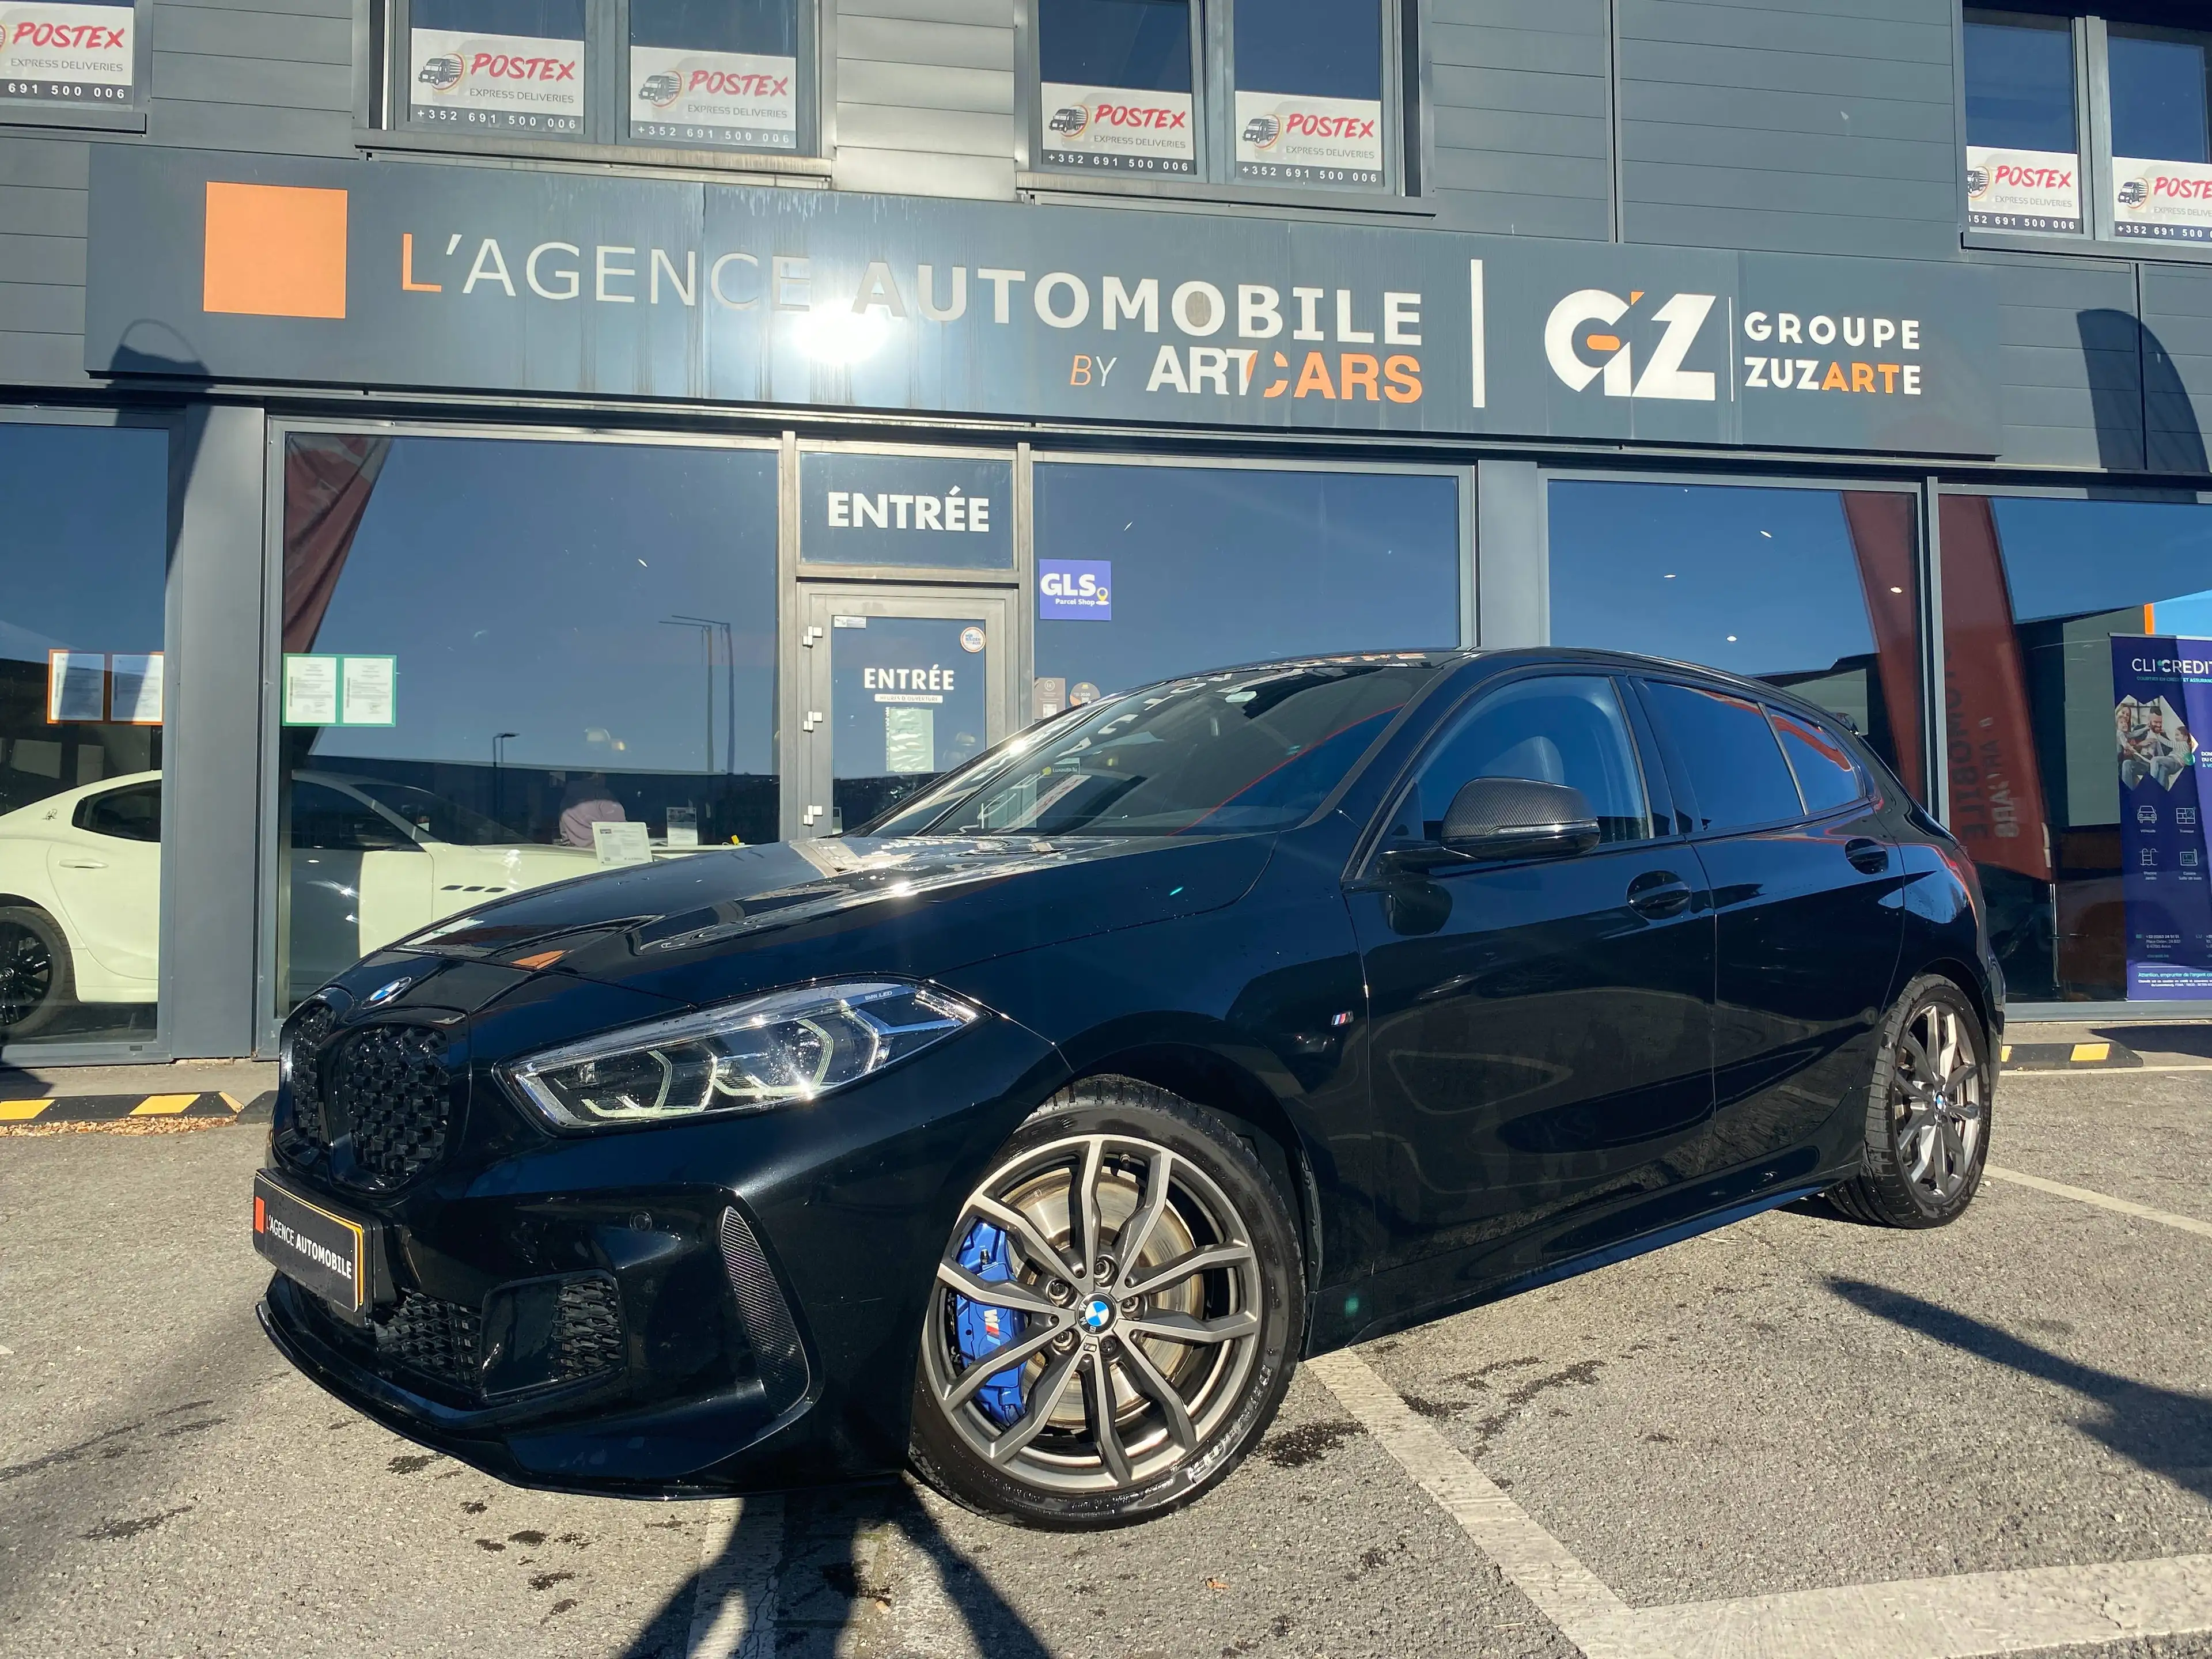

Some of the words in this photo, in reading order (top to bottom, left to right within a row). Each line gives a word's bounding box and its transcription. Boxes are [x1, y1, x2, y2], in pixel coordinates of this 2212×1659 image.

[12, 22, 124, 50] POSTEX
[11, 58, 58, 68] EXPRESS
[62, 60, 123, 71] DELIVERIES
[470, 53, 575, 82] POSTEX
[8, 83, 38, 94] 691
[51, 86, 82, 96] 500
[94, 88, 124, 99] 006
[688, 70, 788, 97] POSTEX
[470, 88, 514, 99] EXPRESS
[518, 92, 574, 103] DELIVERIES
[418, 109, 457, 120] +352
[469, 112, 496, 123] 691
[509, 116, 536, 126] 500
[548, 118, 575, 128] 006
[688, 105, 730, 114] EXPRESS
[733, 108, 787, 118] DELIVERIES
[1094, 104, 1185, 129] POSTEX
[638, 126, 676, 136] +352
[687, 128, 713, 139] 691
[725, 131, 751, 141] 500
[763, 133, 789, 143] 006
[1286, 113, 1374, 139] POSTEX
[1094, 135, 1133, 144] EXPRESS
[1136, 138, 1185, 148] DELIVERIES
[1286, 146, 1324, 155] EXPRESS
[1326, 149, 1374, 158] DELIVERIES
[1049, 153, 1084, 164] +352
[1093, 156, 1118, 166] 691
[1128, 159, 1153, 168] 500
[1163, 161, 1188, 171] 006
[1243, 165, 1277, 176] +352
[1286, 168, 1309, 178] 691
[1319, 171, 1343, 180] 500
[1353, 172, 1376, 182] 006
[1995, 165, 2071, 188] POSTEX
[1995, 195, 2028, 204] EXPRESS
[2030, 198, 2072, 207] DELIVERIES
[2154, 207, 2186, 215] EXPRESS
[1995, 217, 2016, 225] 691
[2024, 218, 2046, 228] 500
[2053, 220, 2074, 230] 006
[2118, 225, 2146, 234] +352
[2154, 226, 2174, 236] 691
[2182, 229, 2202, 237] 500
[402, 233, 811, 312] L'AGENCE
[851, 261, 1422, 346] AUTOMOBILE
[1744, 312, 1920, 350] GROUPE
[1070, 354, 1118, 388] BY
[1146, 346, 1422, 404] ARTCARS
[1744, 357, 1922, 395] ZUZARTE
[828, 485, 989, 532] ENTRÉE
[1041, 573, 1096, 596] GLS
[864, 664, 954, 690] ENTRÉE
[267, 1215, 294, 1247] L'AGENCE
[296, 1233, 352, 1280] AUTOMOBILE
